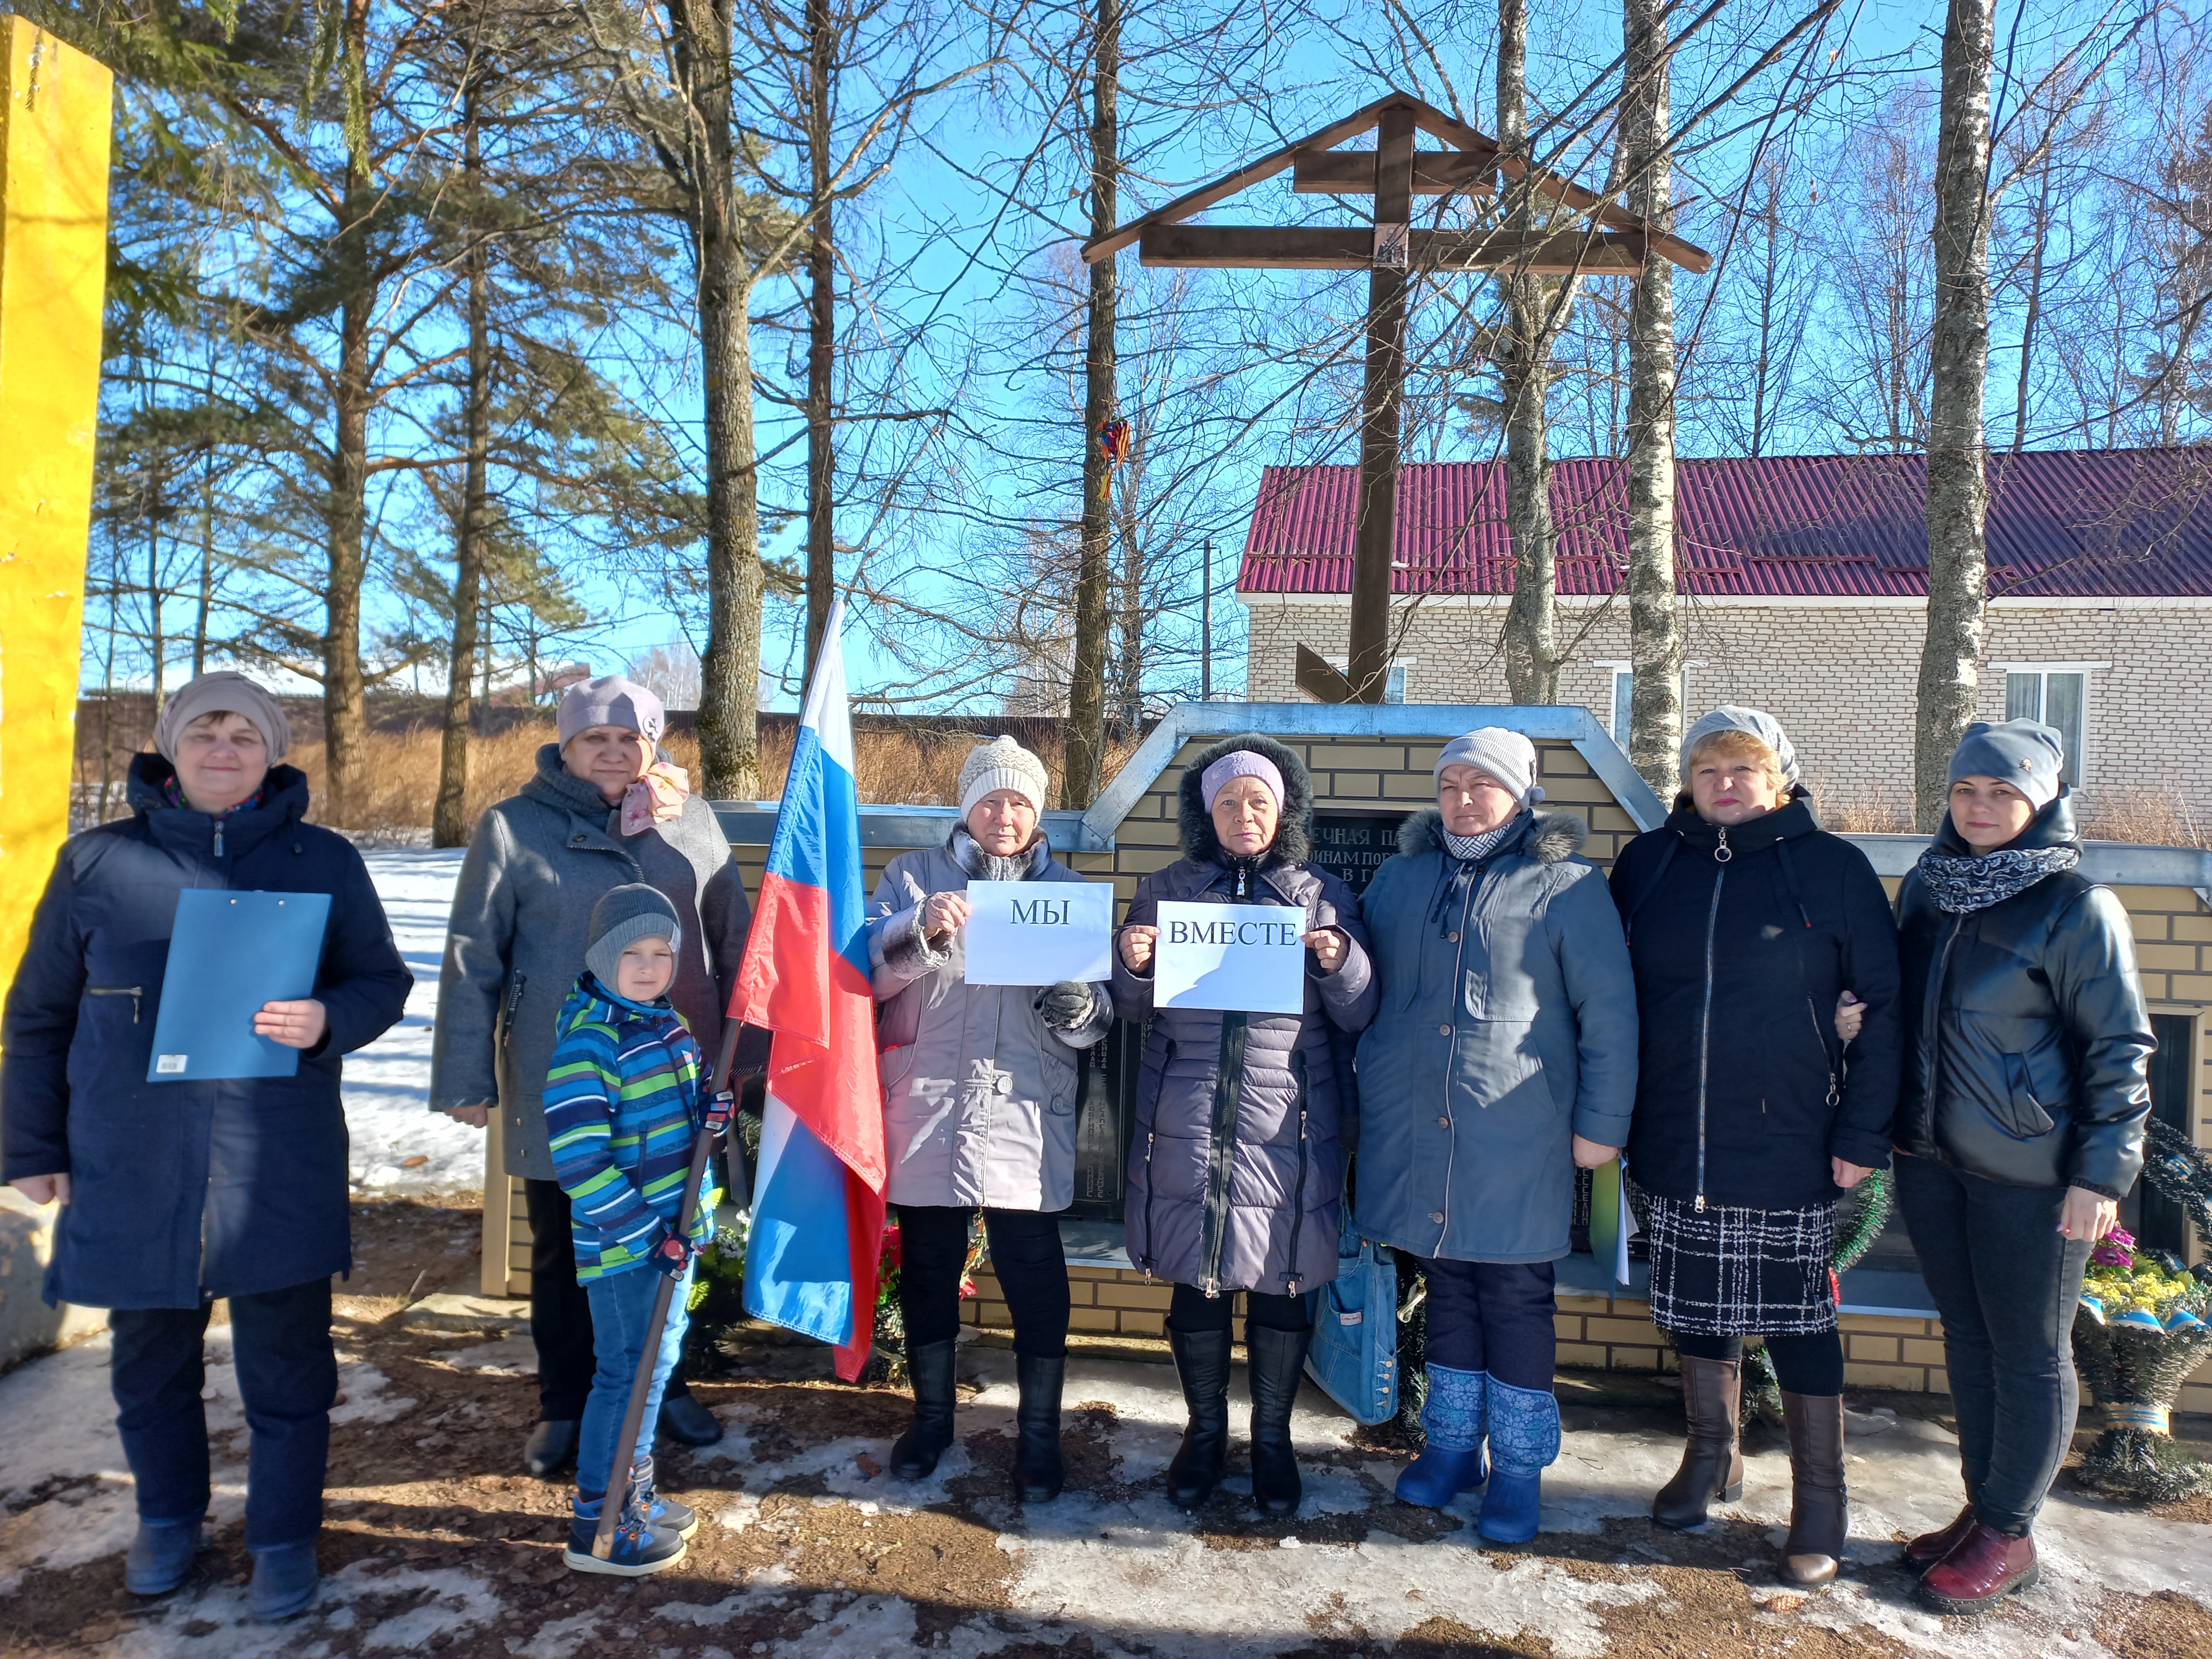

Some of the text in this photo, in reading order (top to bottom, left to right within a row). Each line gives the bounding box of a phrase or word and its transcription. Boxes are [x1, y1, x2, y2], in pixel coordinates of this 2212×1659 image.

[1312, 828, 1371, 845] ЕЧНАЯ
[1308, 850, 1359, 864] ОИНАМ
[1342, 868, 1354, 882] В
[1009, 899, 1072, 925] МЫ
[1168, 921, 1297, 946] ВМЕСТЕ
